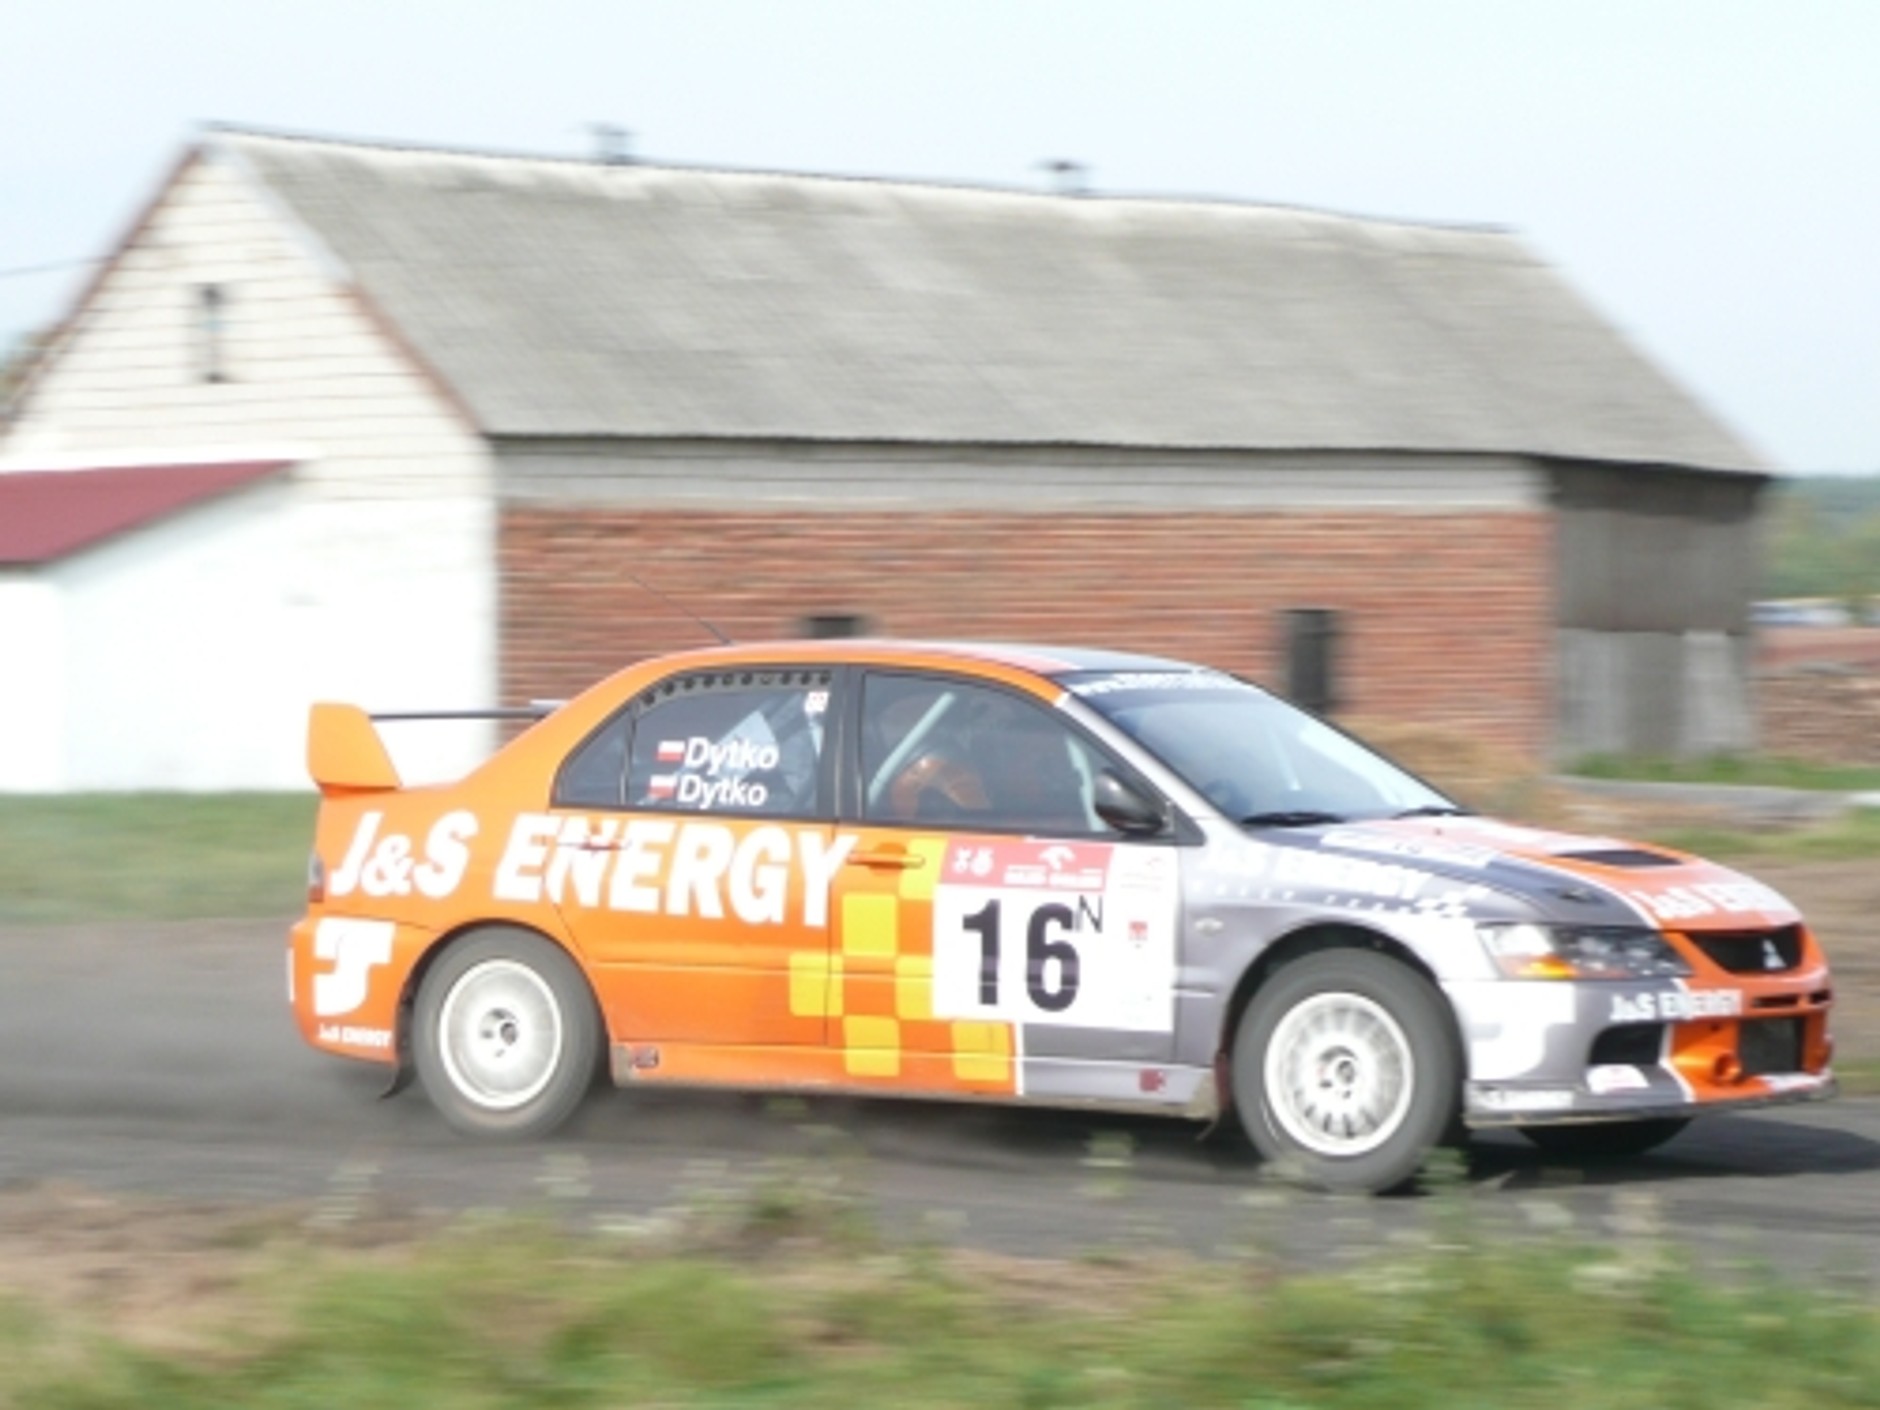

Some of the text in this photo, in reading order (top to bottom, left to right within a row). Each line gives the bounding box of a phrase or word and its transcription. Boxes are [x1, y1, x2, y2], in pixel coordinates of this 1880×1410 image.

[677, 773, 768, 809] Dytko
[684, 736, 779, 776] Dytko
[329, 808, 859, 927] J&S ENERGY
[962, 898, 1081, 1012] 16
